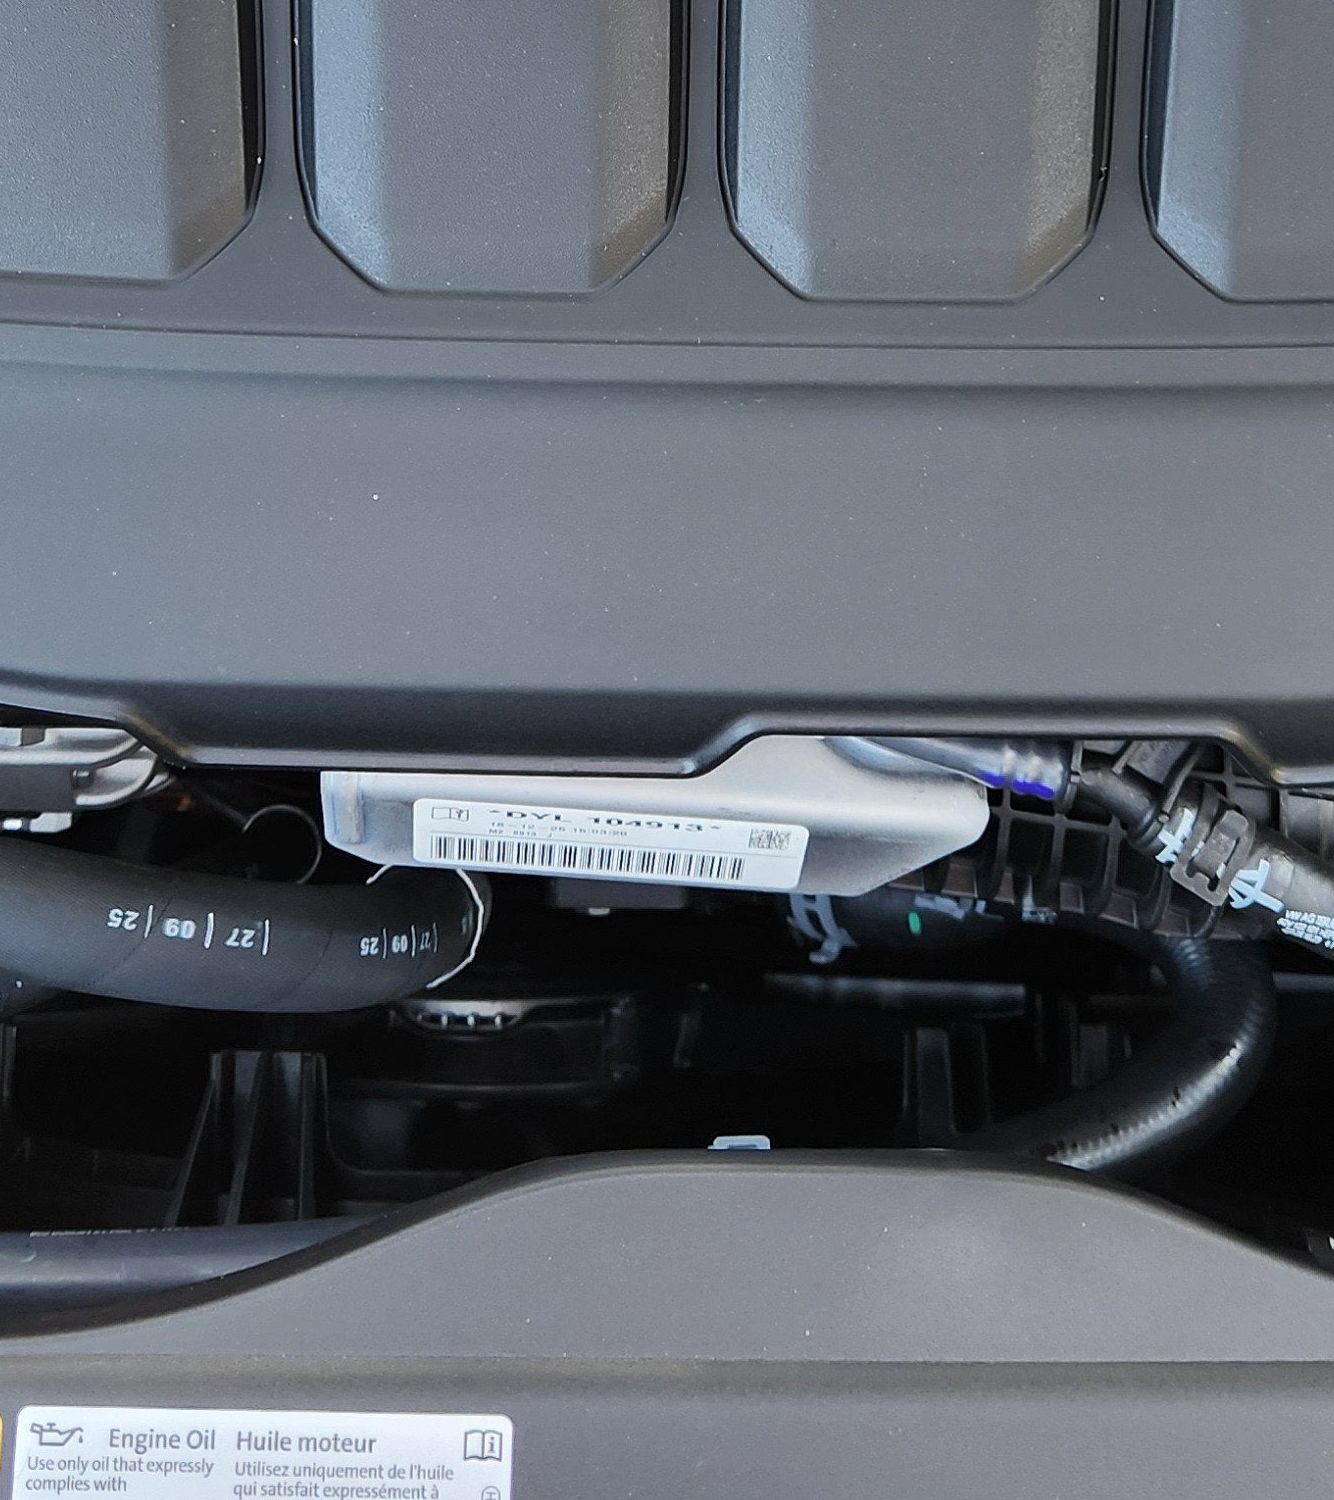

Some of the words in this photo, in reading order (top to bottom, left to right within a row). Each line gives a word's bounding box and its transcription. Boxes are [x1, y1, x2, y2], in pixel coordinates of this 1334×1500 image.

[107, 908, 140, 931] 25
[164, 918, 196, 939] 09
[225, 928, 256, 948] 27
[109, 1428, 181, 1455] Engine
[186, 1429, 216, 1451] Oil
[236, 1430, 292, 1452] Huile
[298, 1433, 377, 1453] moteur
[27, 1456, 55, 1472] Use
[57, 1456, 88, 1476] only
[92, 1456, 110, 1472] oil
[113, 1456, 143, 1473] that
[146, 1458, 214, 1478] expressly
[235, 1461, 289, 1478] Utilisez
[292, 1463, 384, 1485] uniquement
[387, 1463, 406, 1480] de
[409, 1464, 454, 1481] l'huile
[26, 1476, 90, 1495] complies
[93, 1477, 127, 1492] with
[233, 1482, 257, 1500] qui
[260, 1482, 319, 1498] satisfait
[322, 1483, 427, 1500] expressément
[430, 1484, 440, 1500] à
